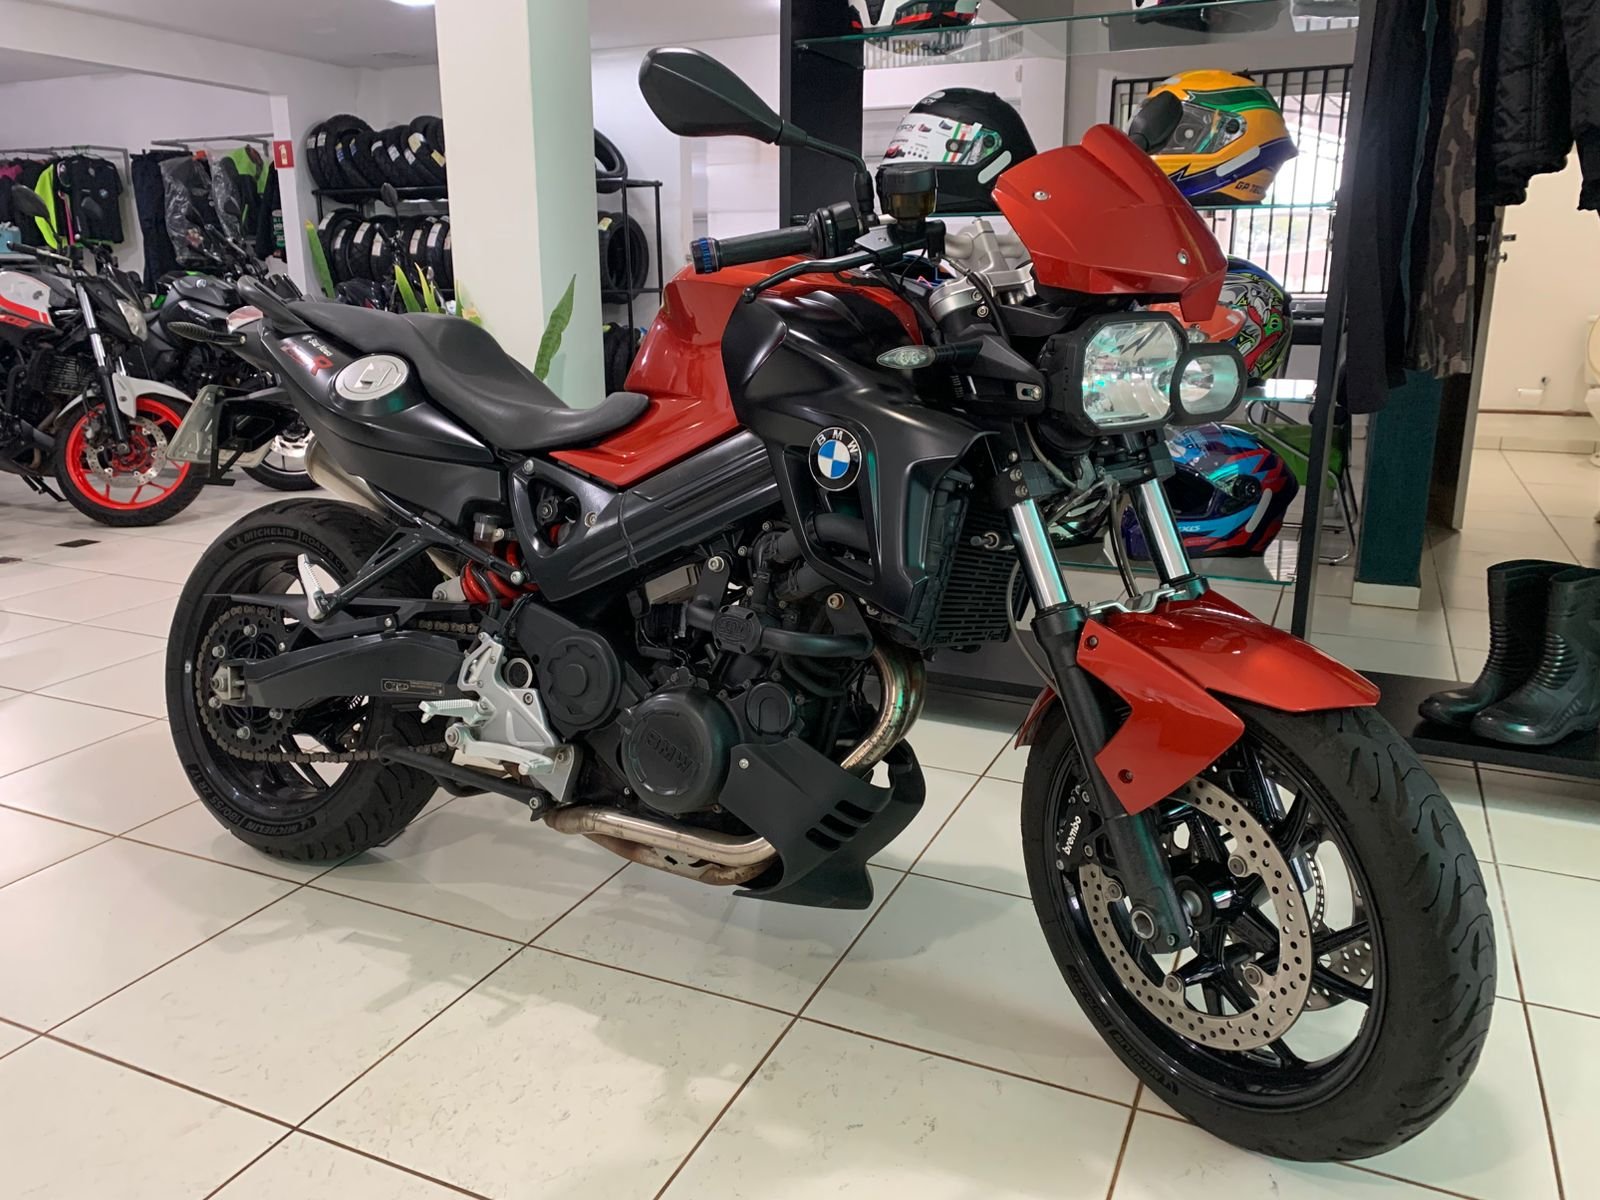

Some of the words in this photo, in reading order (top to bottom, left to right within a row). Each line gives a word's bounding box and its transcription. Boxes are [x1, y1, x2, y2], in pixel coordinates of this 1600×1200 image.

[816, 429, 858, 453] BMW
[244, 527, 294, 541] MICHELIN
[302, 534, 328, 553] ROAD
[208, 795, 241, 823] 180/55
[246, 821, 298, 834] MICHELIN
[1062, 816, 1082, 856] brembo
